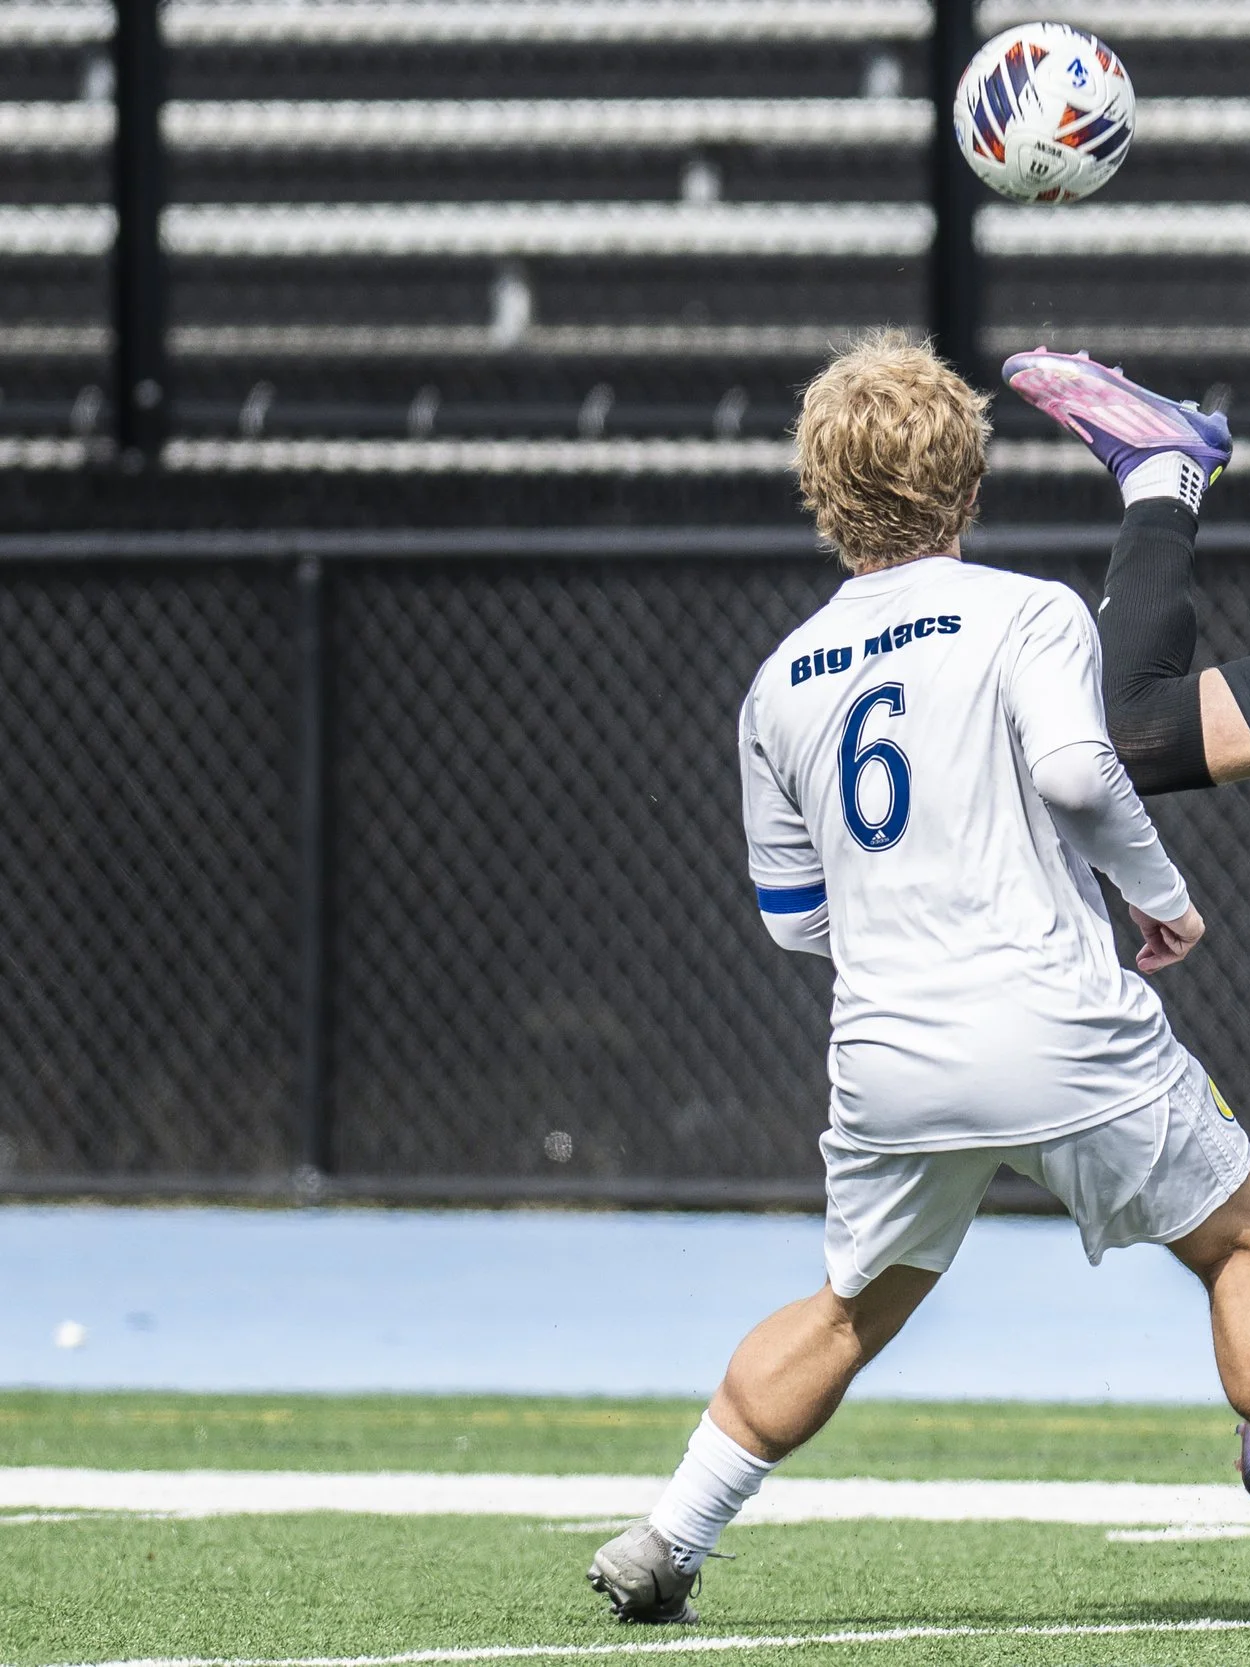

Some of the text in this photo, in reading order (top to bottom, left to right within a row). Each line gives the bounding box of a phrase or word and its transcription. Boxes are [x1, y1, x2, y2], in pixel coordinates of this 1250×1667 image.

[791, 615, 961, 687] Big Macs
[837, 682, 911, 852] 6
